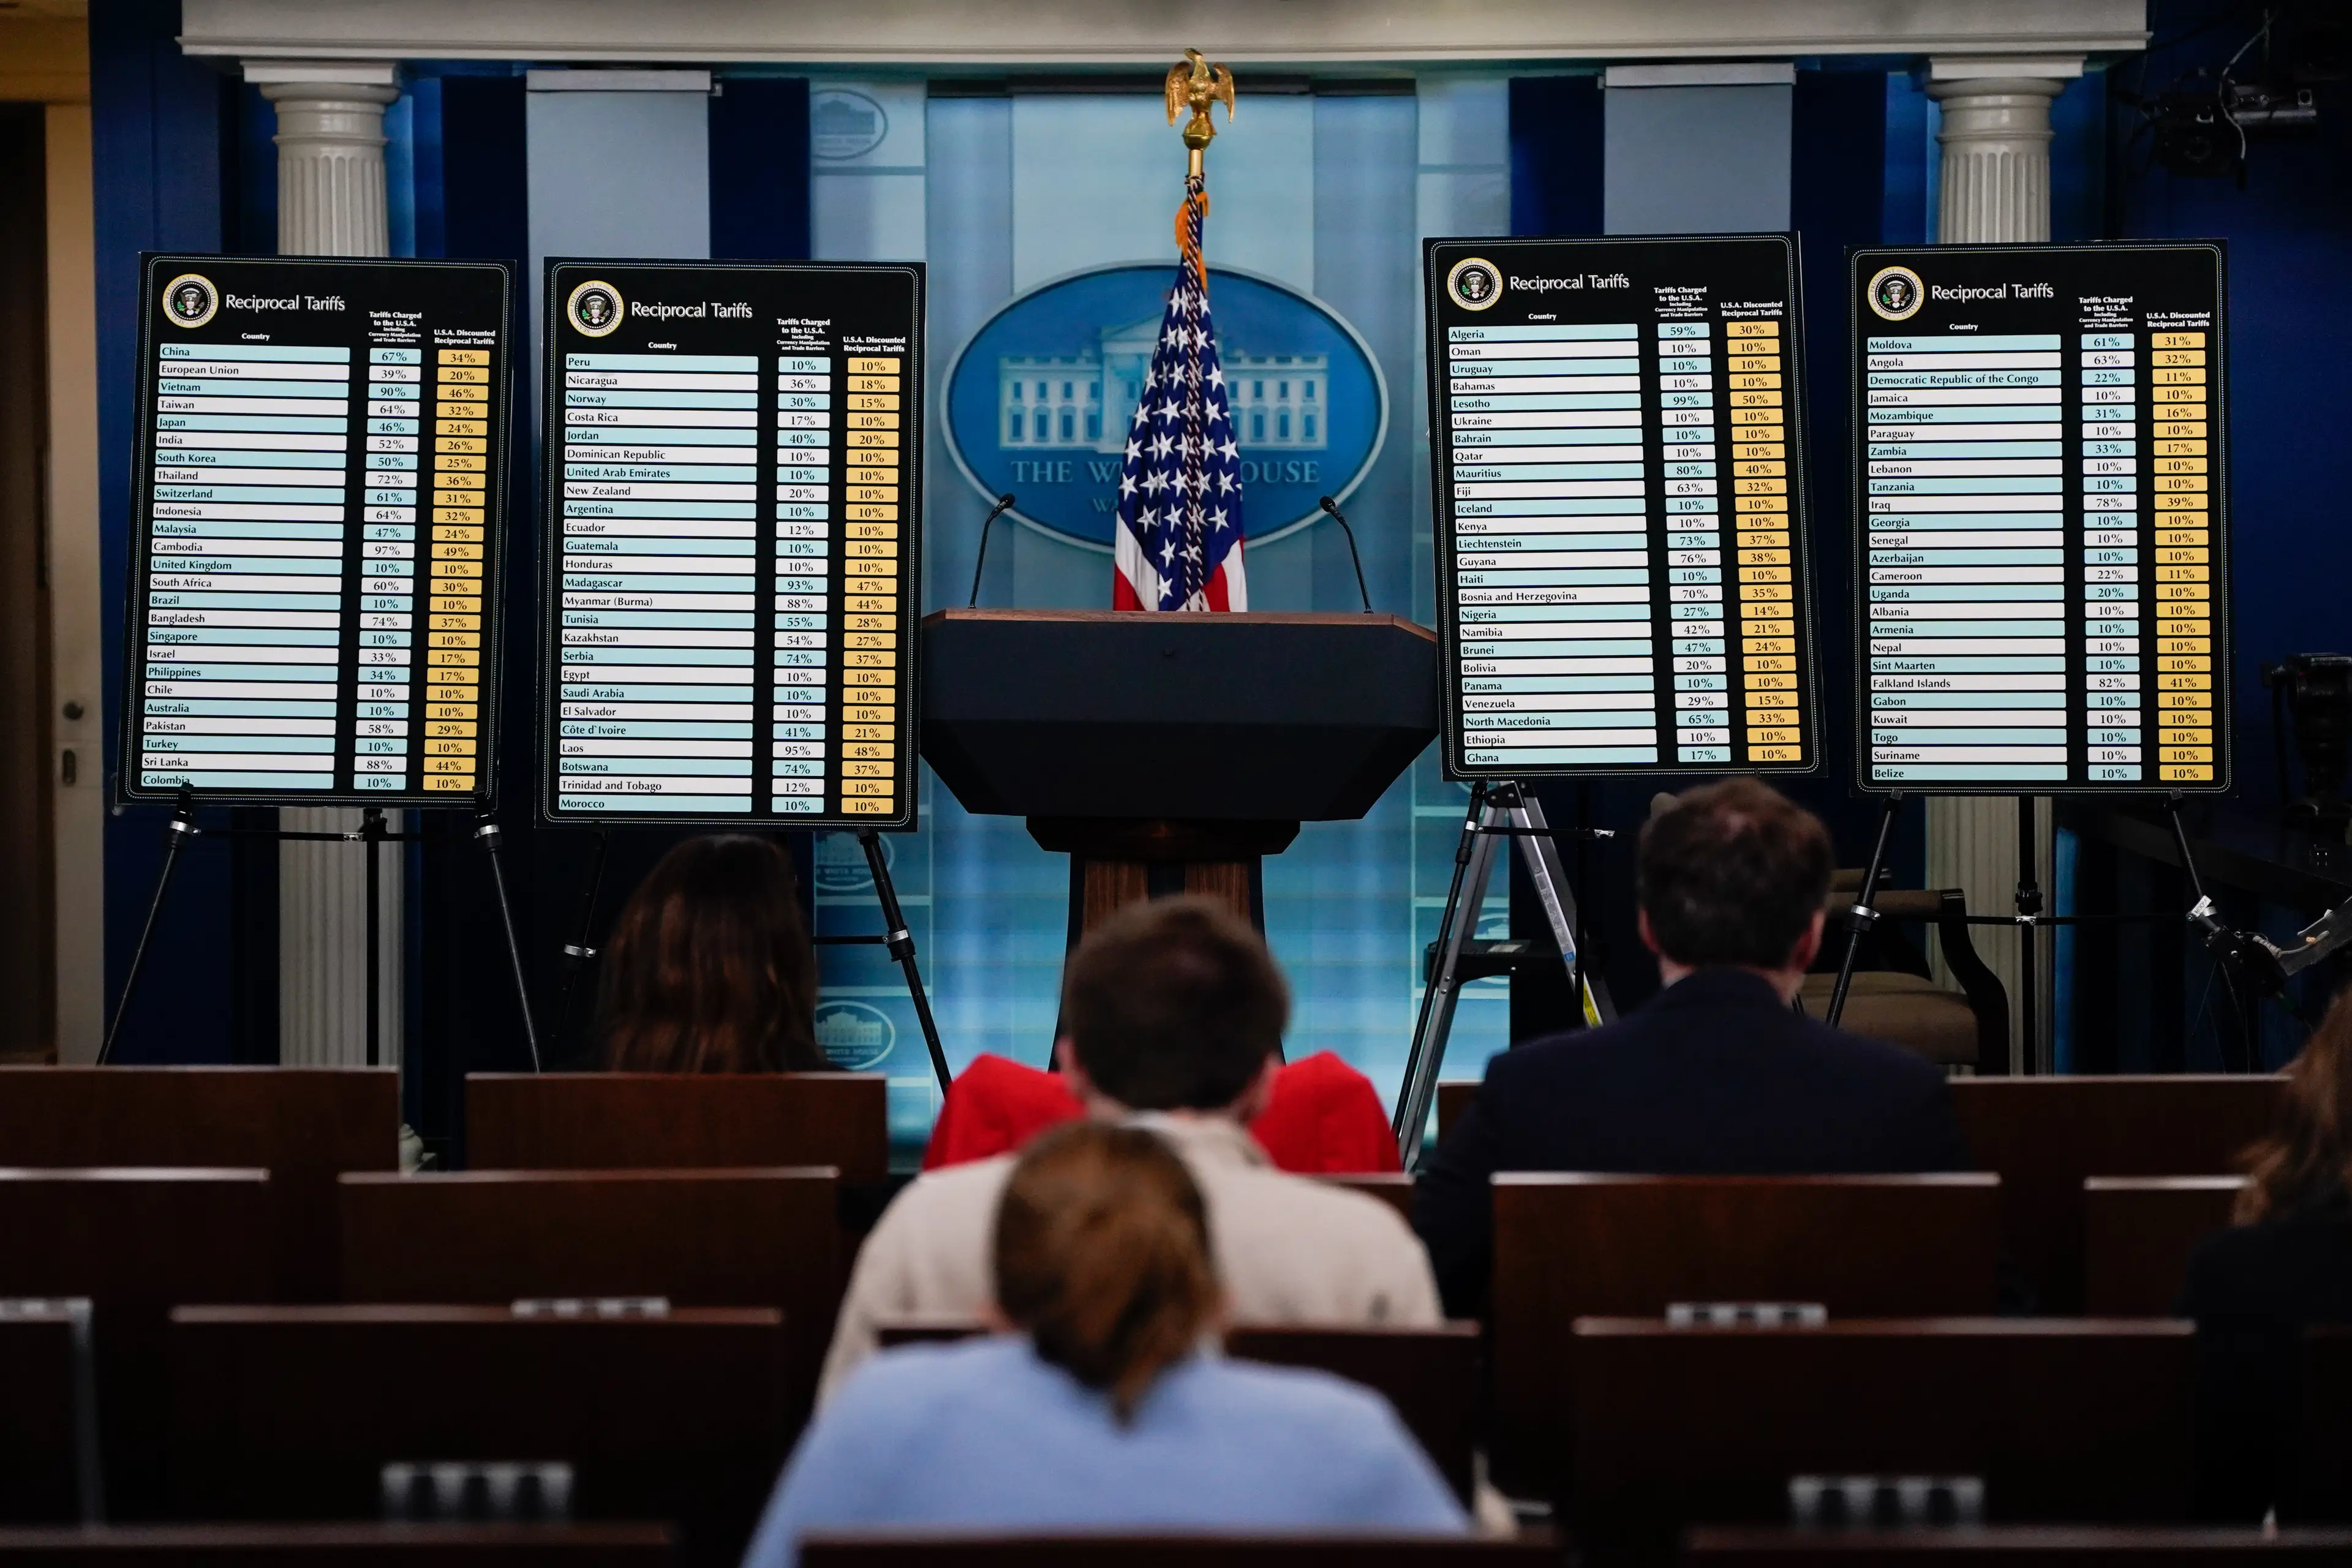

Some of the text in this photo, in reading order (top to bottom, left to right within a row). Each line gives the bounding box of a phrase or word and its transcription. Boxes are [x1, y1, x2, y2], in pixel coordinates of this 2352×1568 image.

[1510, 274, 1630, 294] Reciprocal Tariffs
[1932, 283, 2054, 304] Reciprocal Tariffs
[226, 295, 345, 313] Reciprocal Tariffs
[631, 301, 752, 322] Reciprocal Tariffs
[1670, 326, 1696, 336] 59%
[1740, 325, 1765, 334] 30%
[1451, 330, 1485, 341] Algeria
[648, 342, 677, 350] Country
[1870, 340, 1912, 349] Moldova
[2094, 337, 2120, 347] 61%
[2165, 336, 2191, 346] 31%
[162, 347, 190, 356] China
[382, 352, 407, 362] 67%
[450, 353, 475, 363] 34%
[568, 357, 590, 366] Peru
[162, 364, 239, 376] European Union
[792, 360, 816, 371] 10%
[861, 361, 886, 371] 10%
[381, 369, 407, 379] 39%
[450, 371, 475, 380] 20%
[1453, 399, 1490, 408] Lesotho
[1673, 396, 1699, 405] 99%
[1743, 394, 1768, 404] 50%
[1871, 410, 1934, 422] Mozambique
[2095, 409, 2121, 418] 31%
[2167, 408, 2192, 418] 16%
[567, 467, 671, 478] United Arab Emirates
[791, 470, 815, 480] 10%
[860, 470, 884, 481] 10%
[1010, 460, 1073, 483] THE
[1239, 460, 1320, 483] OUSE
[1457, 486, 1471, 497] Fiji
[1677, 483, 1703, 492] 63%
[1747, 481, 1773, 492] 32%
[156, 488, 213, 499] Switzerland
[376, 492, 402, 502] 61%
[445, 494, 471, 503] 31%
[1871, 500, 1891, 511] Iraq
[2096, 497, 2122, 508] 78%
[2167, 497, 2193, 507] 39%
[1459, 538, 1522, 548] Liechtenstein
[1679, 535, 1706, 546] 73%
[1749, 534, 1776, 545] 37%
[566, 541, 619, 551] Guatemala
[789, 543, 814, 554] 10%
[859, 544, 883, 554] 10%
[153, 560, 232, 571] United Kingdom
[375, 563, 400, 573] 10%
[444, 564, 469, 575] 10%
[1461, 591, 1577, 603] Bosnia and Herzegovina
[1682, 589, 1708, 599] 70%
[1752, 587, 1778, 598] 35%
[1872, 589, 1910, 600] Uganda
[2098, 587, 2124, 598] 20%
[2170, 587, 2195, 597] 10%
[565, 614, 598, 624] Tunisia
[787, 617, 813, 627] 55%
[856, 617, 882, 628] 28%
[150, 631, 198, 643] Singapore
[372, 635, 397, 644] 10%
[442, 636, 466, 646] 10%
[1873, 661, 1936, 670] Sint Maarten
[2100, 659, 2125, 670] 10%
[2171, 659, 2196, 669] 10%
[564, 670, 590, 681] Egypt
[787, 672, 812, 682] 10%
[857, 673, 881, 683] 10%
[146, 721, 186, 731] Pakistan
[368, 724, 394, 734] 58%
[437, 725, 463, 735] 29%
[1467, 753, 1499, 763] Ghana
[1691, 750, 1717, 760] 17%
[1762, 749, 1787, 760] 10%
[1874, 750, 1920, 760] Suriname
[2101, 750, 2127, 761] 10%
[2173, 750, 2198, 761] 10%
[562, 762, 608, 772] Botswana
[785, 764, 810, 774] 74%
[854, 764, 880, 775] 37%
